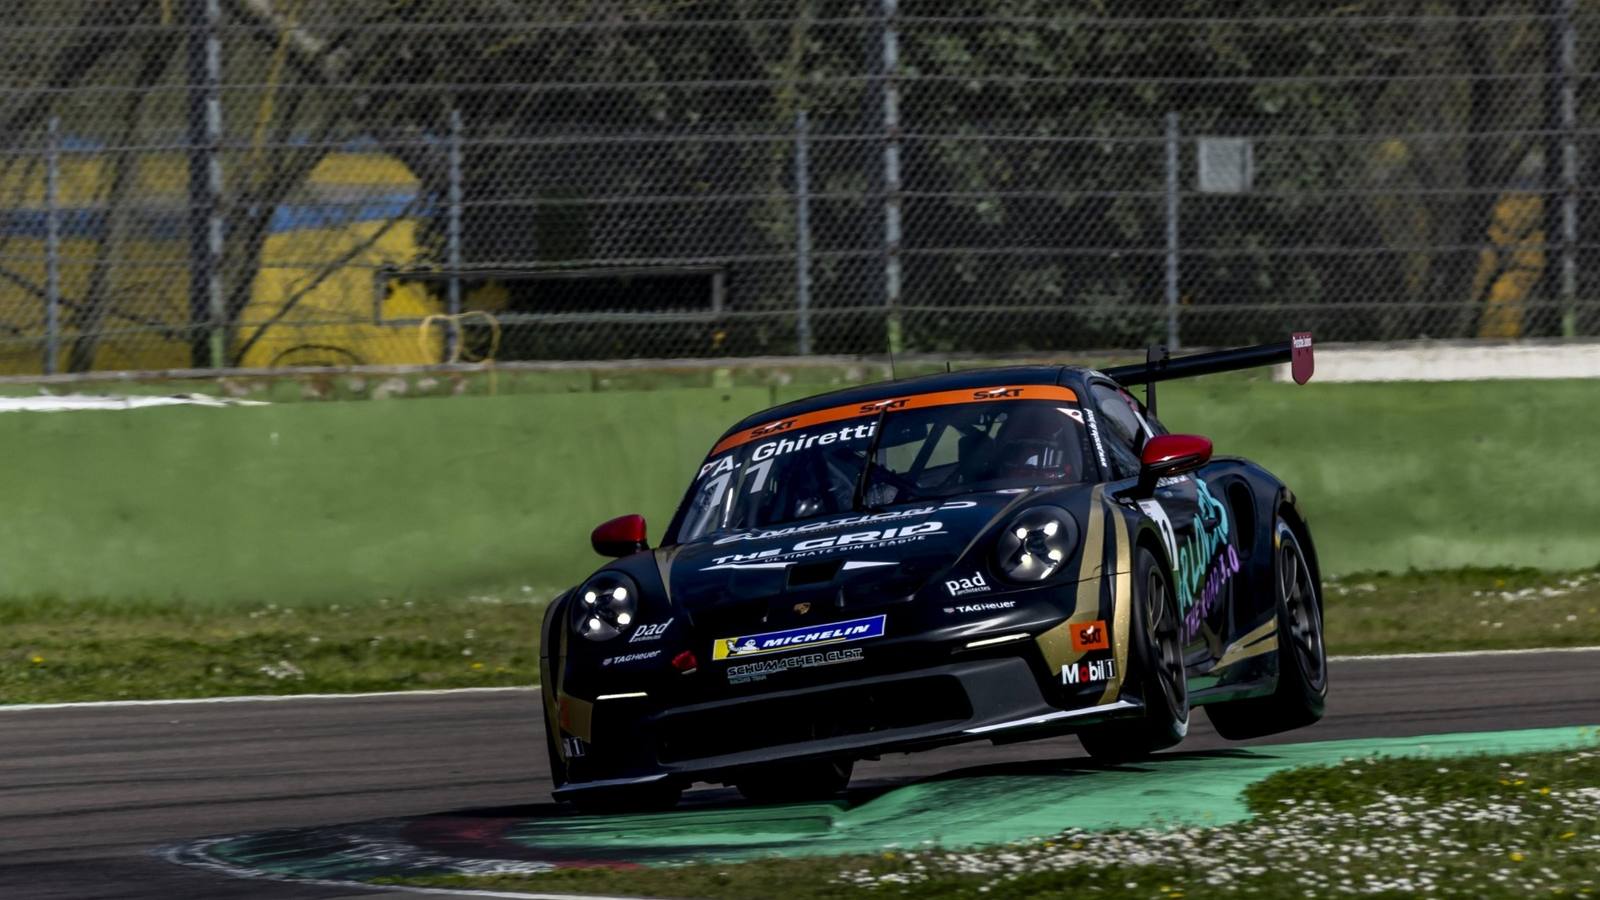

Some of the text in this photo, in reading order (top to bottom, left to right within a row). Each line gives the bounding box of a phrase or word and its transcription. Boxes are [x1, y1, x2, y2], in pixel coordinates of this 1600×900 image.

[711, 421, 878, 477] A. Ghiretti
[712, 548, 782, 564] THE
[793, 521, 943, 550] GRID
[765, 535, 926, 562] ULTIMATE SIM LEAGUE
[945, 571, 987, 596] pad
[628, 617, 674, 643] pad
[763, 624, 870, 647] MICHELIN
[727, 653, 825, 677] SCHUMACHER
[1061, 660, 1105, 684] Mobil
